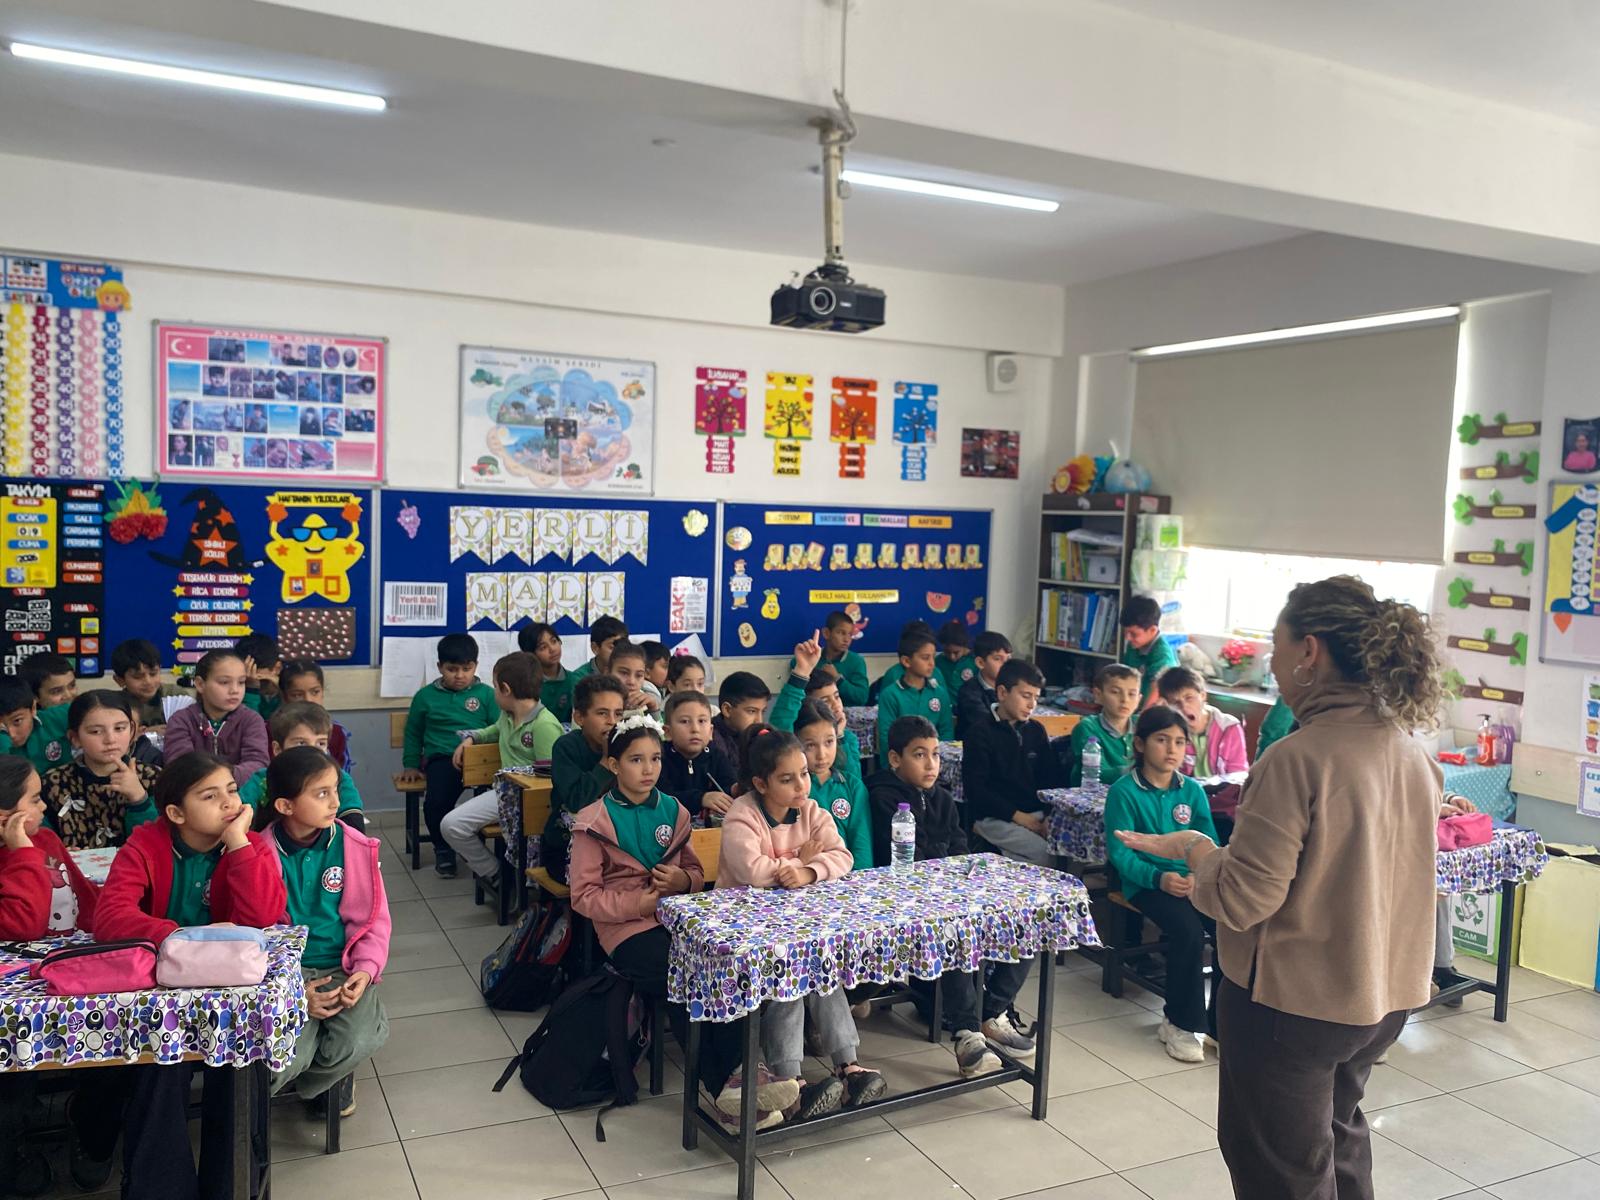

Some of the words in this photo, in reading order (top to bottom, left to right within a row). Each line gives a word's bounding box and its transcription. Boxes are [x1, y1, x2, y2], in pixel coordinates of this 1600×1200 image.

[6, 483, 51, 497] TAKVİM
[16, 513, 39, 522] OCAK
[74, 514, 93, 523] SALI
[460, 514, 636, 540] YERLİ
[18, 540, 40, 549] CUMA
[74, 573, 95, 582] PAZAR
[219, 574, 243, 584] EDERİM
[18, 587, 42, 596] YILLAR
[191, 586, 209, 596] RİCA
[213, 587, 239, 596] EDERİM
[476, 579, 613, 603] MALI
[213, 600, 240, 610] DİLERİM
[400, 596, 418, 604] Yerli
[70, 603, 90, 612] HAVA
[215, 613, 240, 623] EDERİM
[196, 639, 234, 649] AFEDERSİN
[1458, 930, 1477, 942] CAM
